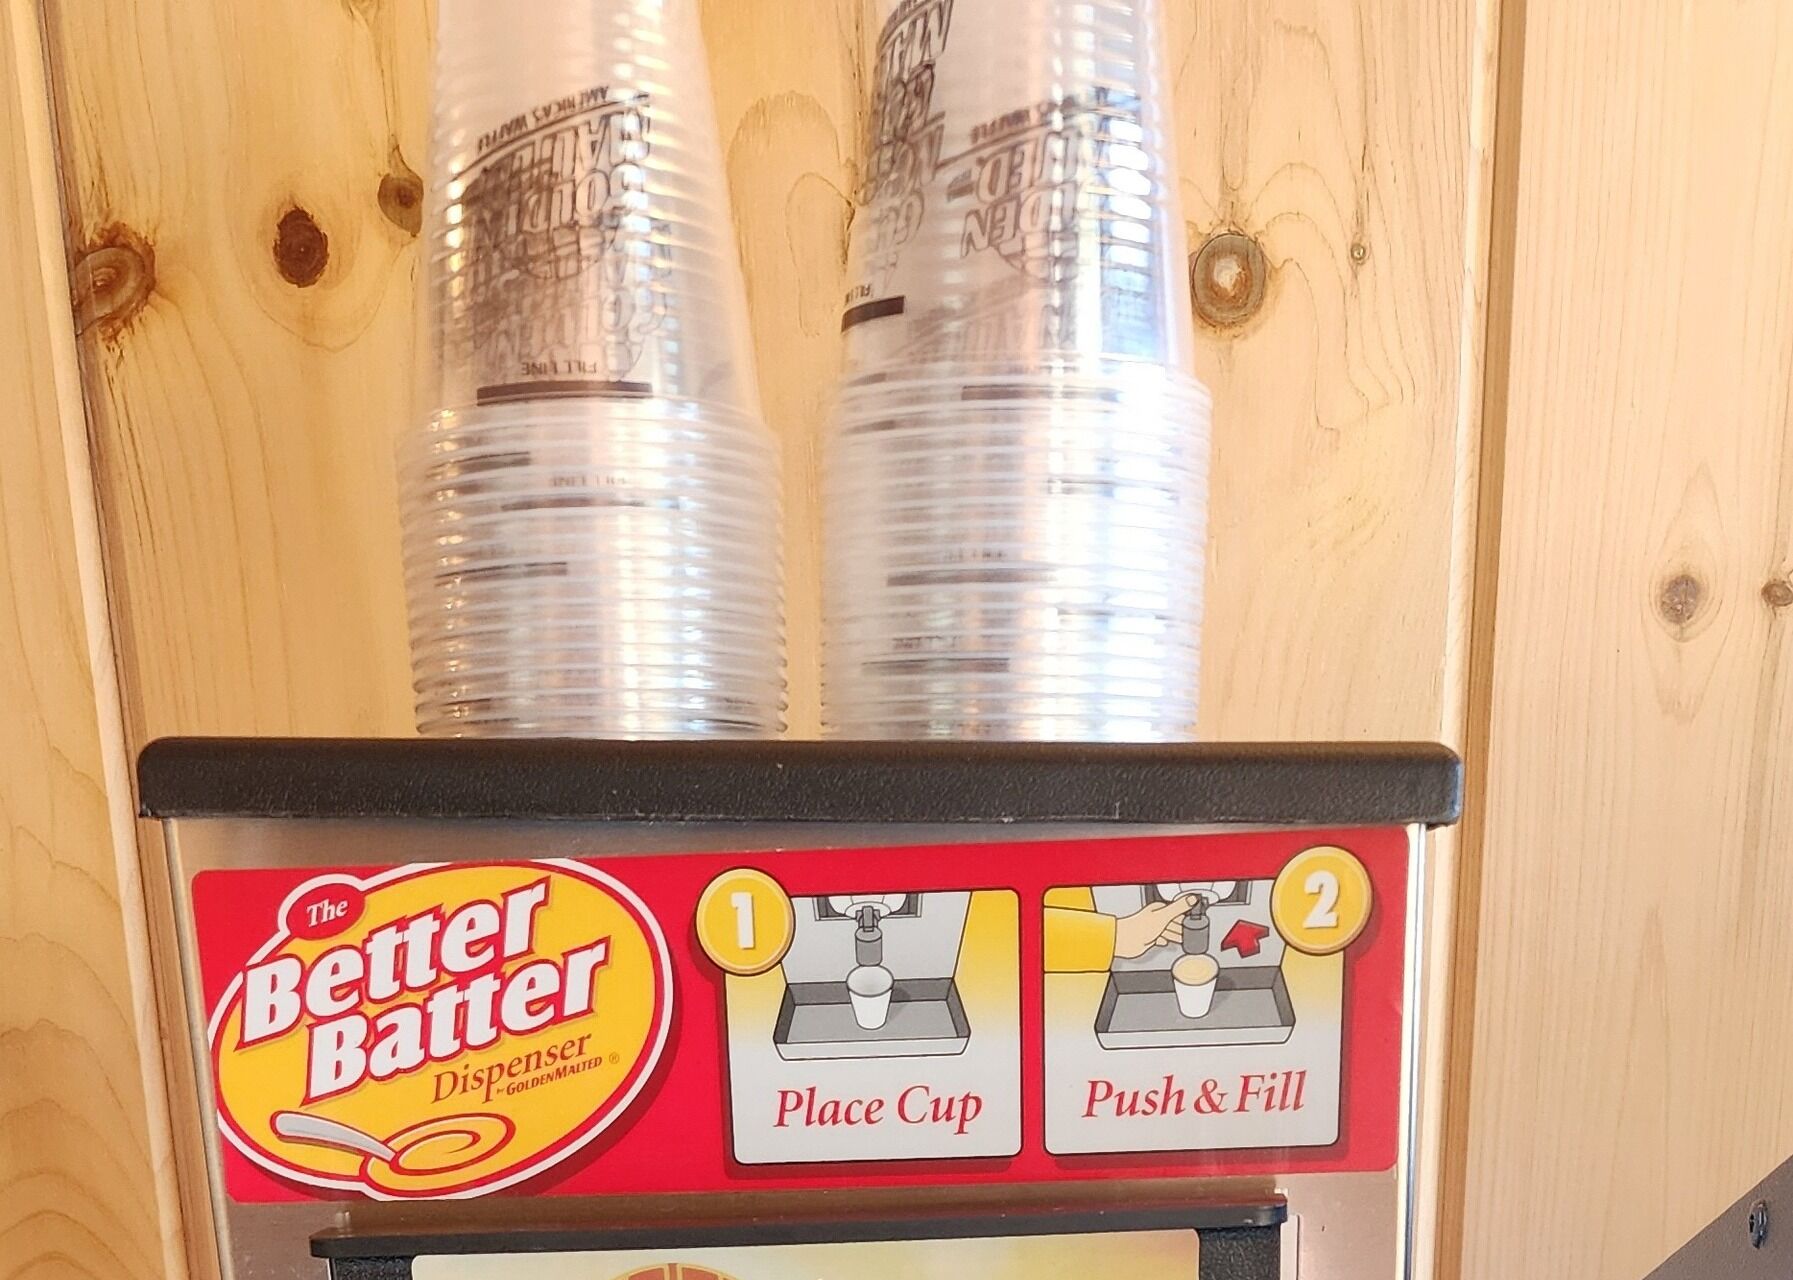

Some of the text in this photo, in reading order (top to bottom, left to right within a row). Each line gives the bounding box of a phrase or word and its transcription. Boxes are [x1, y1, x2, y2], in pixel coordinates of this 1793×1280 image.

[306, 898, 348, 927] The
[731, 892, 756, 949] 1
[1304, 870, 1339, 930] 2
[240, 879, 550, 1046] Better
[304, 938, 609, 1103] Batter
[431, 1033, 592, 1104] Dispenser
[1082, 1070, 1308, 1119] Push & Fill
[773, 1083, 983, 1135] Place Cup
